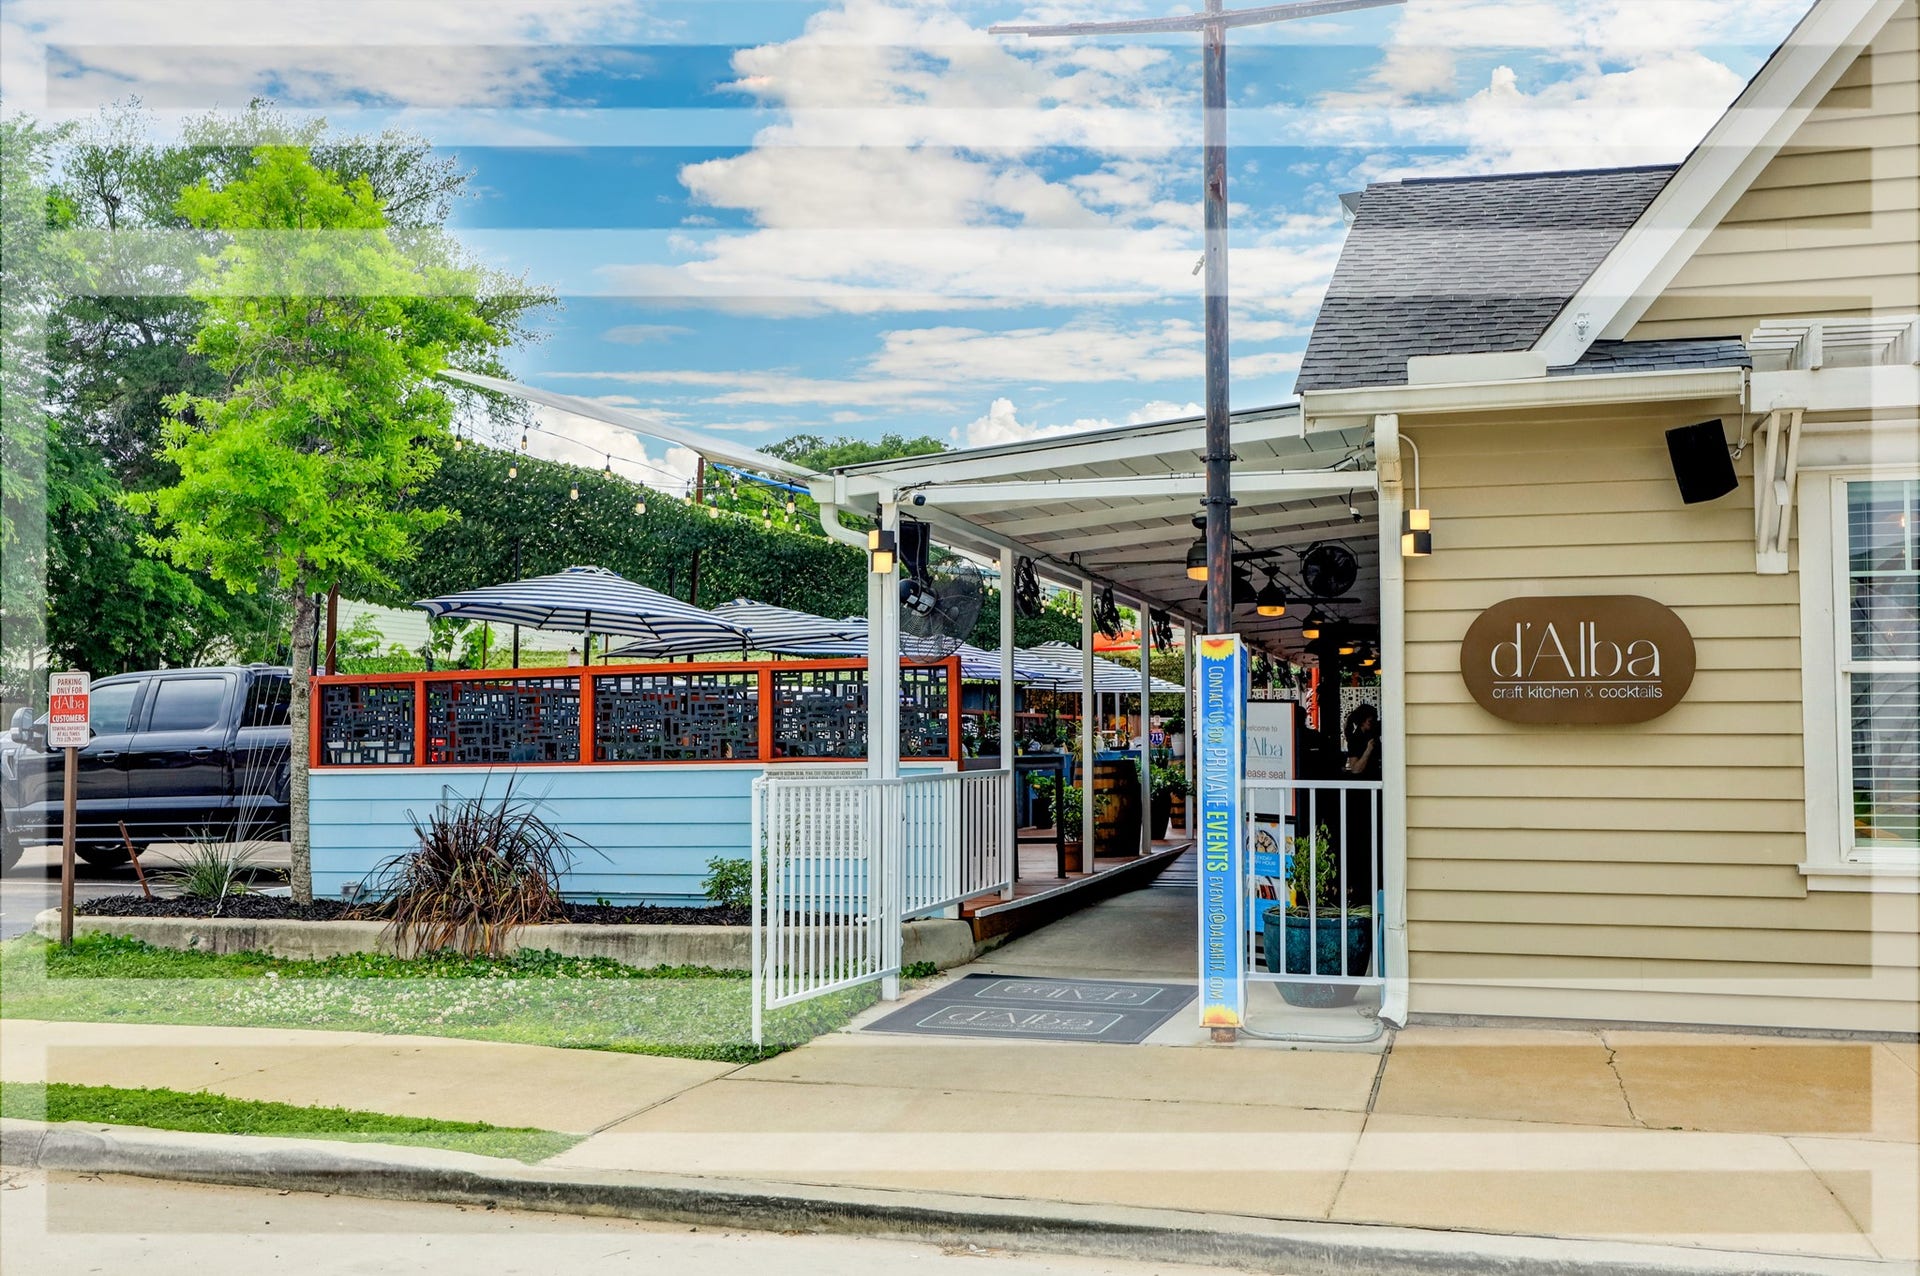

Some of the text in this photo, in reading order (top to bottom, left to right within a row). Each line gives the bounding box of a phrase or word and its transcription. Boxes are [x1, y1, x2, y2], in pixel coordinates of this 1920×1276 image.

[1490, 621, 1661, 678] d'Alba
[57, 678, 82, 686] PARKING
[1492, 683, 1663, 699] craft kitchen & cocktails
[52, 714, 86, 723] CUSTOMERS
[1151, 733, 1163, 741] 713
[1206, 747, 1229, 807] PRIVATE
[1268, 770, 1286, 779] seat
[1206, 811, 1229, 873] EVENTS
